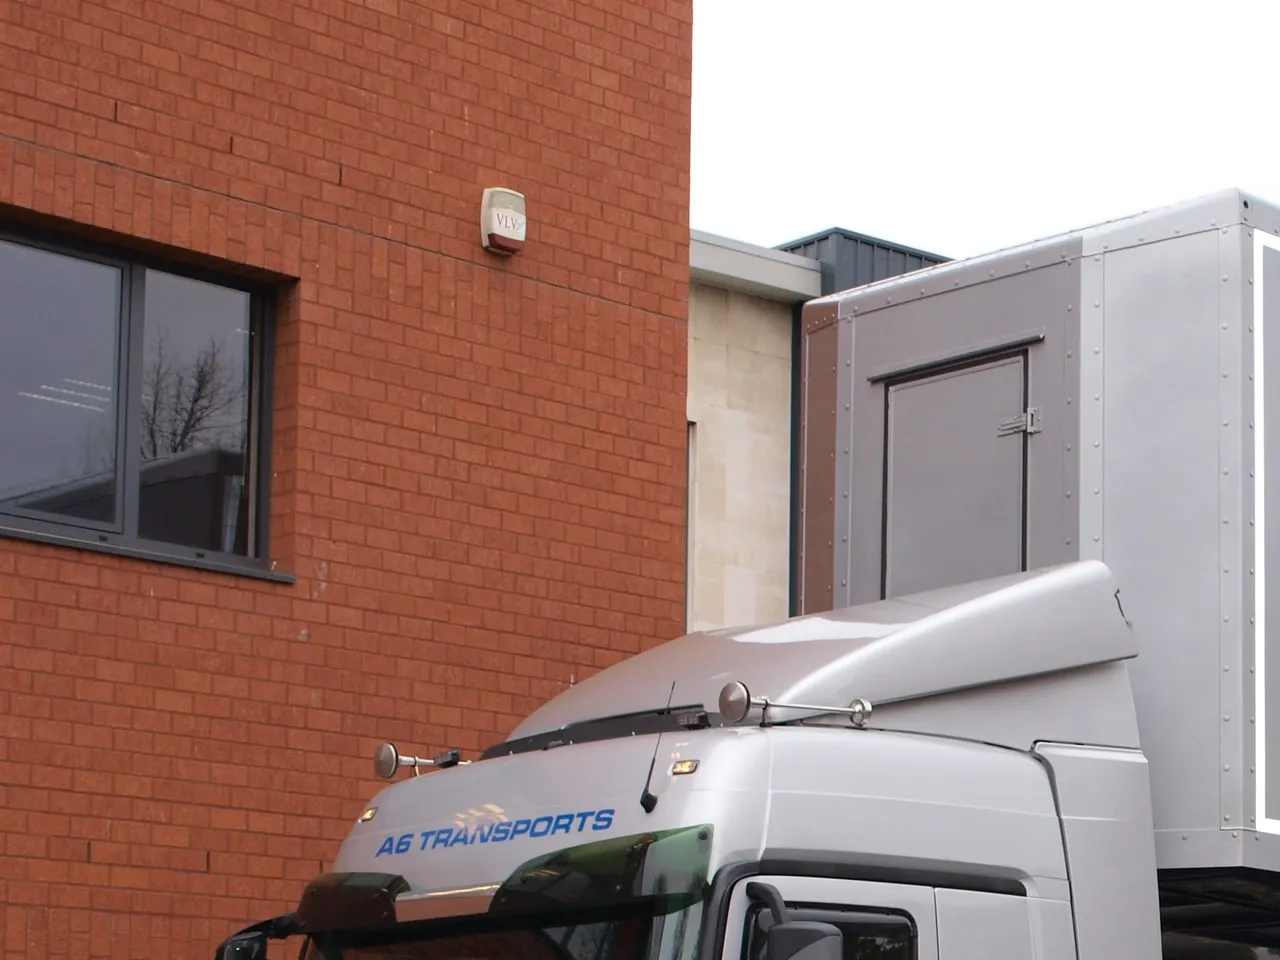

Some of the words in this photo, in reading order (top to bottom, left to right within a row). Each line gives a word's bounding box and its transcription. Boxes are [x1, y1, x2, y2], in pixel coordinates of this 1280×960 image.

[496, 213, 517, 229] VLV
[375, 833, 414, 857] A6
[419, 808, 616, 851] TRANSPORTS
